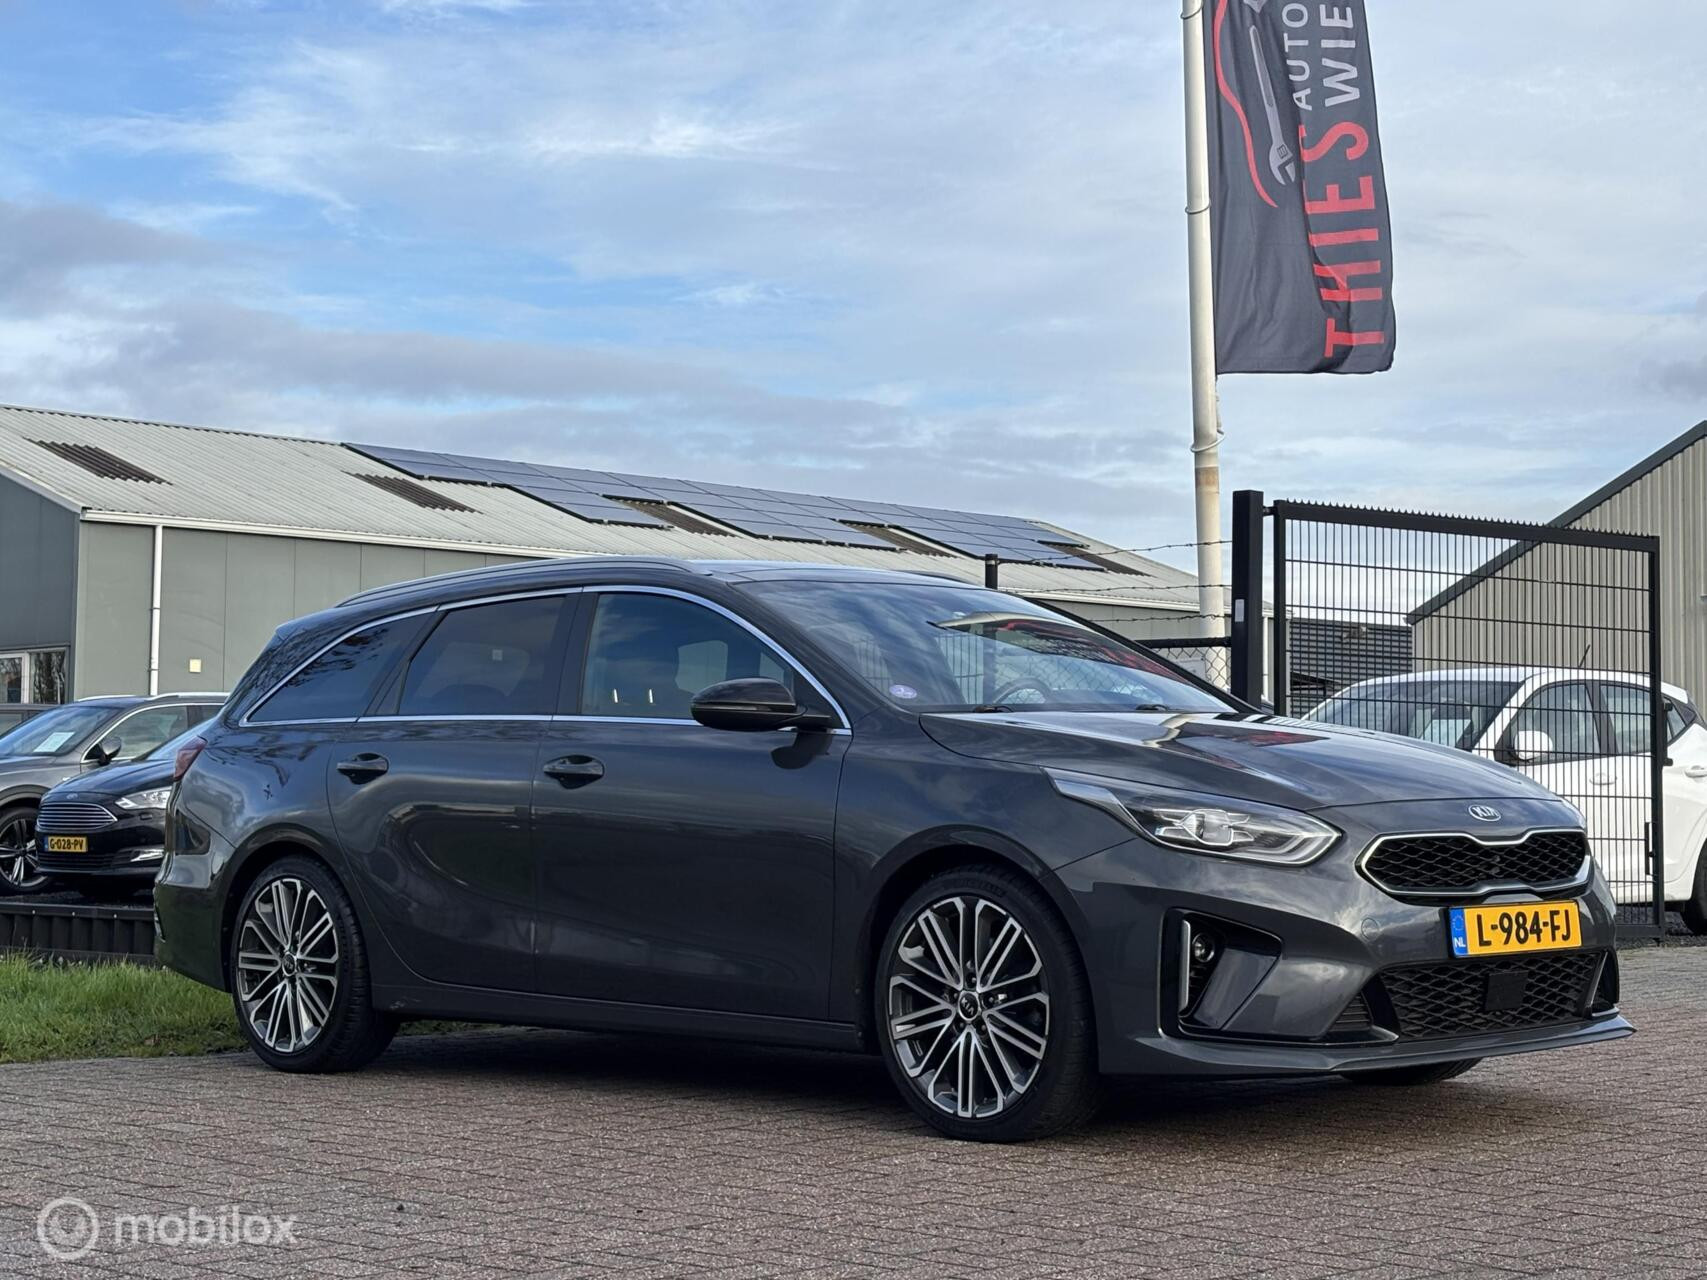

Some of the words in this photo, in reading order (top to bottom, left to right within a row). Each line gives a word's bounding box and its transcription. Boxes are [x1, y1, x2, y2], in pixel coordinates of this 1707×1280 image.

[1282, 3, 1312, 111] AUTO
[1299, 121, 1385, 358] THIES
[1472, 806, 1500, 817] KIA
[49, 838, 84, 850] G-028-PV
[1476, 909, 1571, 947] L-984-FJ
[1454, 937, 1467, 948] NL
